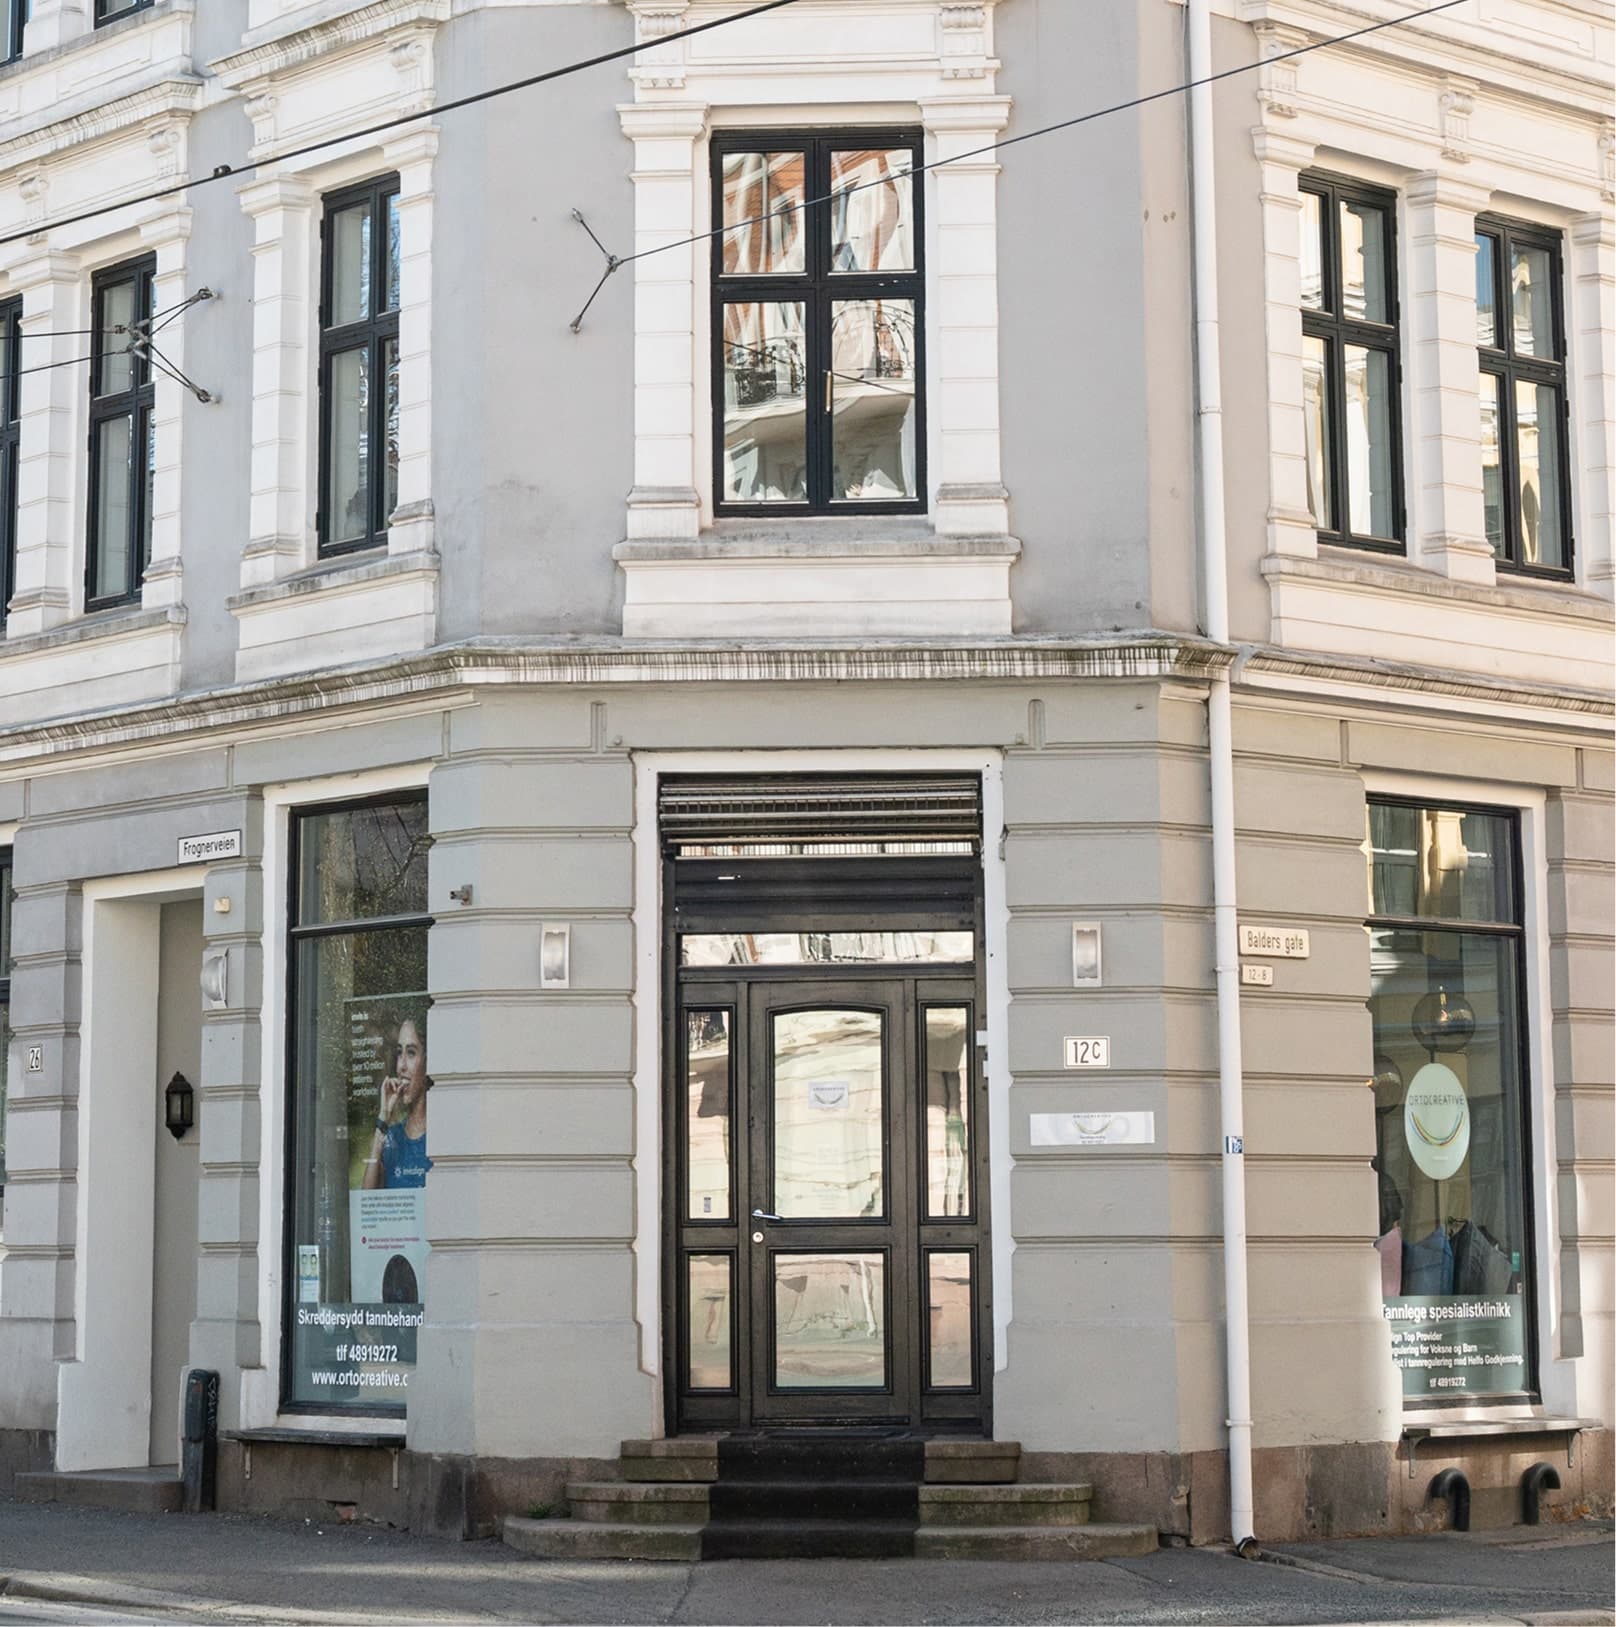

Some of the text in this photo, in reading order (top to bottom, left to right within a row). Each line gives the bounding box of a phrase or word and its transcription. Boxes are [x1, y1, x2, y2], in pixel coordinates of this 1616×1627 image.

[183, 836, 235, 858] Frognerveien
[1248, 930, 1304, 954] Balders gate
[30, 1049, 40, 1069] 26
[1073, 1041, 1101, 1064] 12C
[298, 1309, 424, 1328] Skreddersydd tannbehand
[1429, 1302, 1511, 1322] spesialistklinikk
[1404, 1331, 1416, 1344] Top
[1416, 1331, 1442, 1341] Provider
[336, 1344, 398, 1362] tlf 48919272
[1454, 1345, 1462, 1355] og
